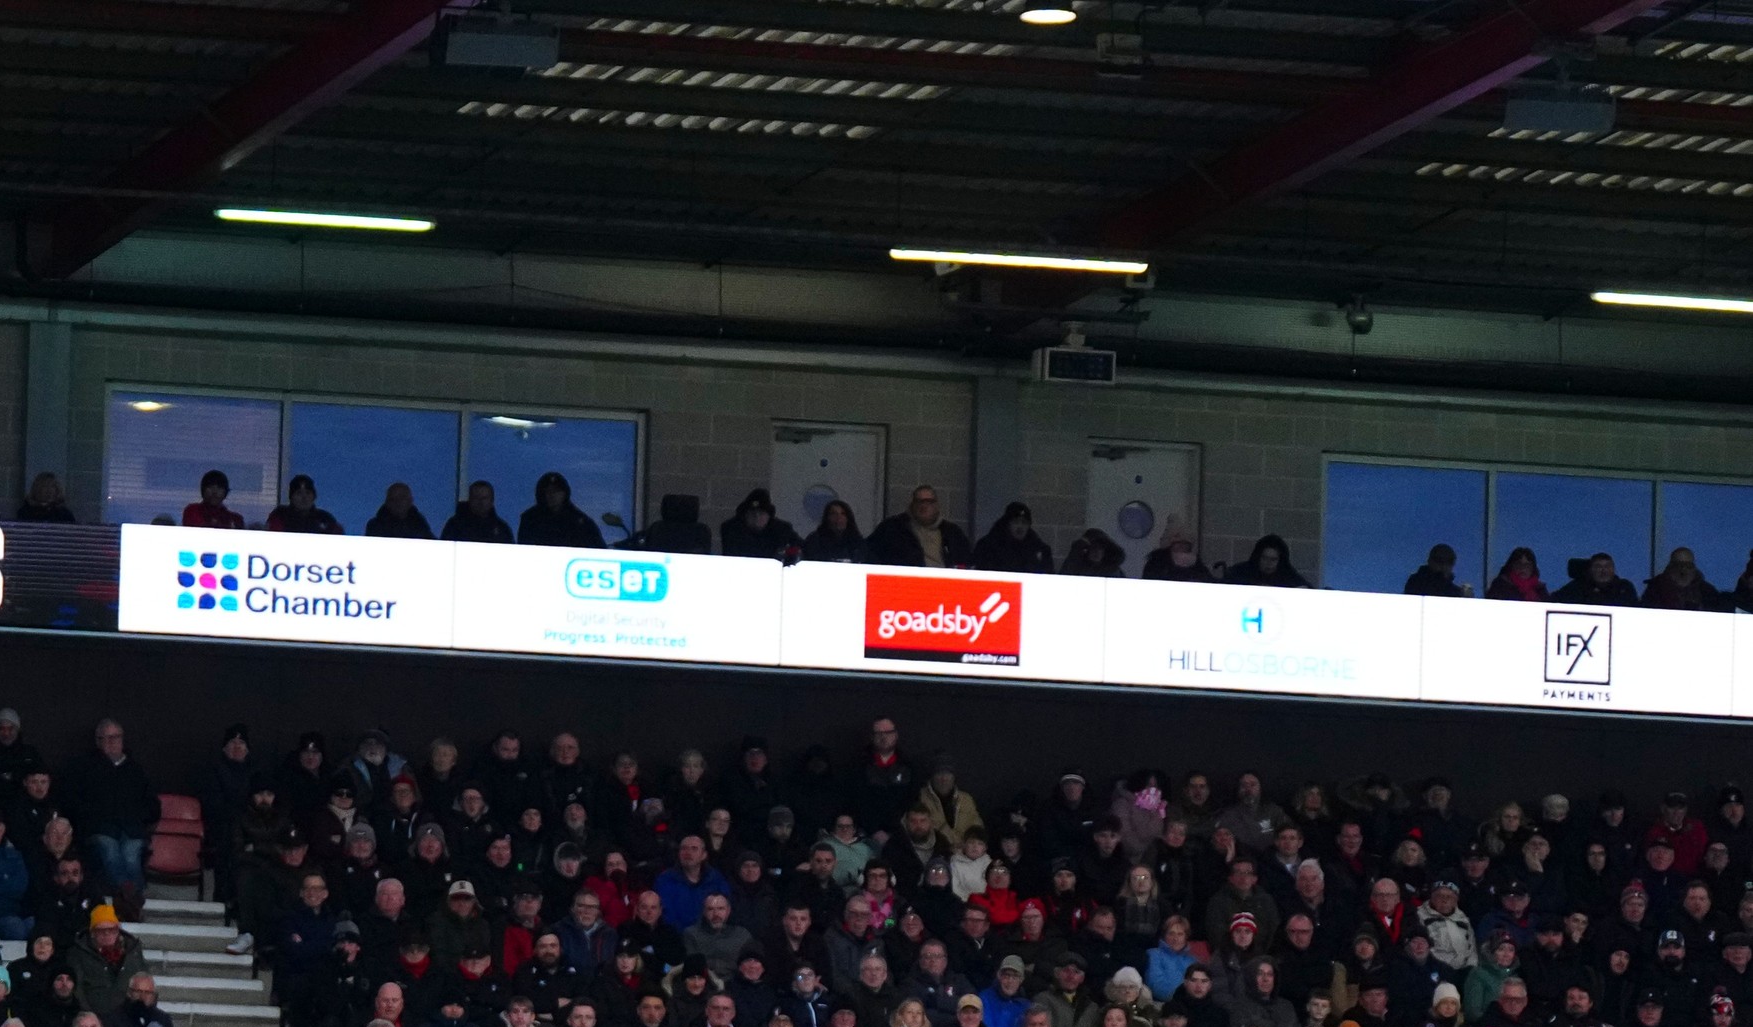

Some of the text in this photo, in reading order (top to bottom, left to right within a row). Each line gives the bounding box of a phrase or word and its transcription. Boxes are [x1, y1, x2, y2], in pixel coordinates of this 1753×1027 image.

[247, 553, 357, 585] Dorset
[244, 586, 397, 620] Chamber
[878, 603, 988, 643] goadsby
[615, 632, 688, 648] Protected
[1556, 625, 1599, 676] IFX
[1543, 688, 1612, 702] PAYMENTS
